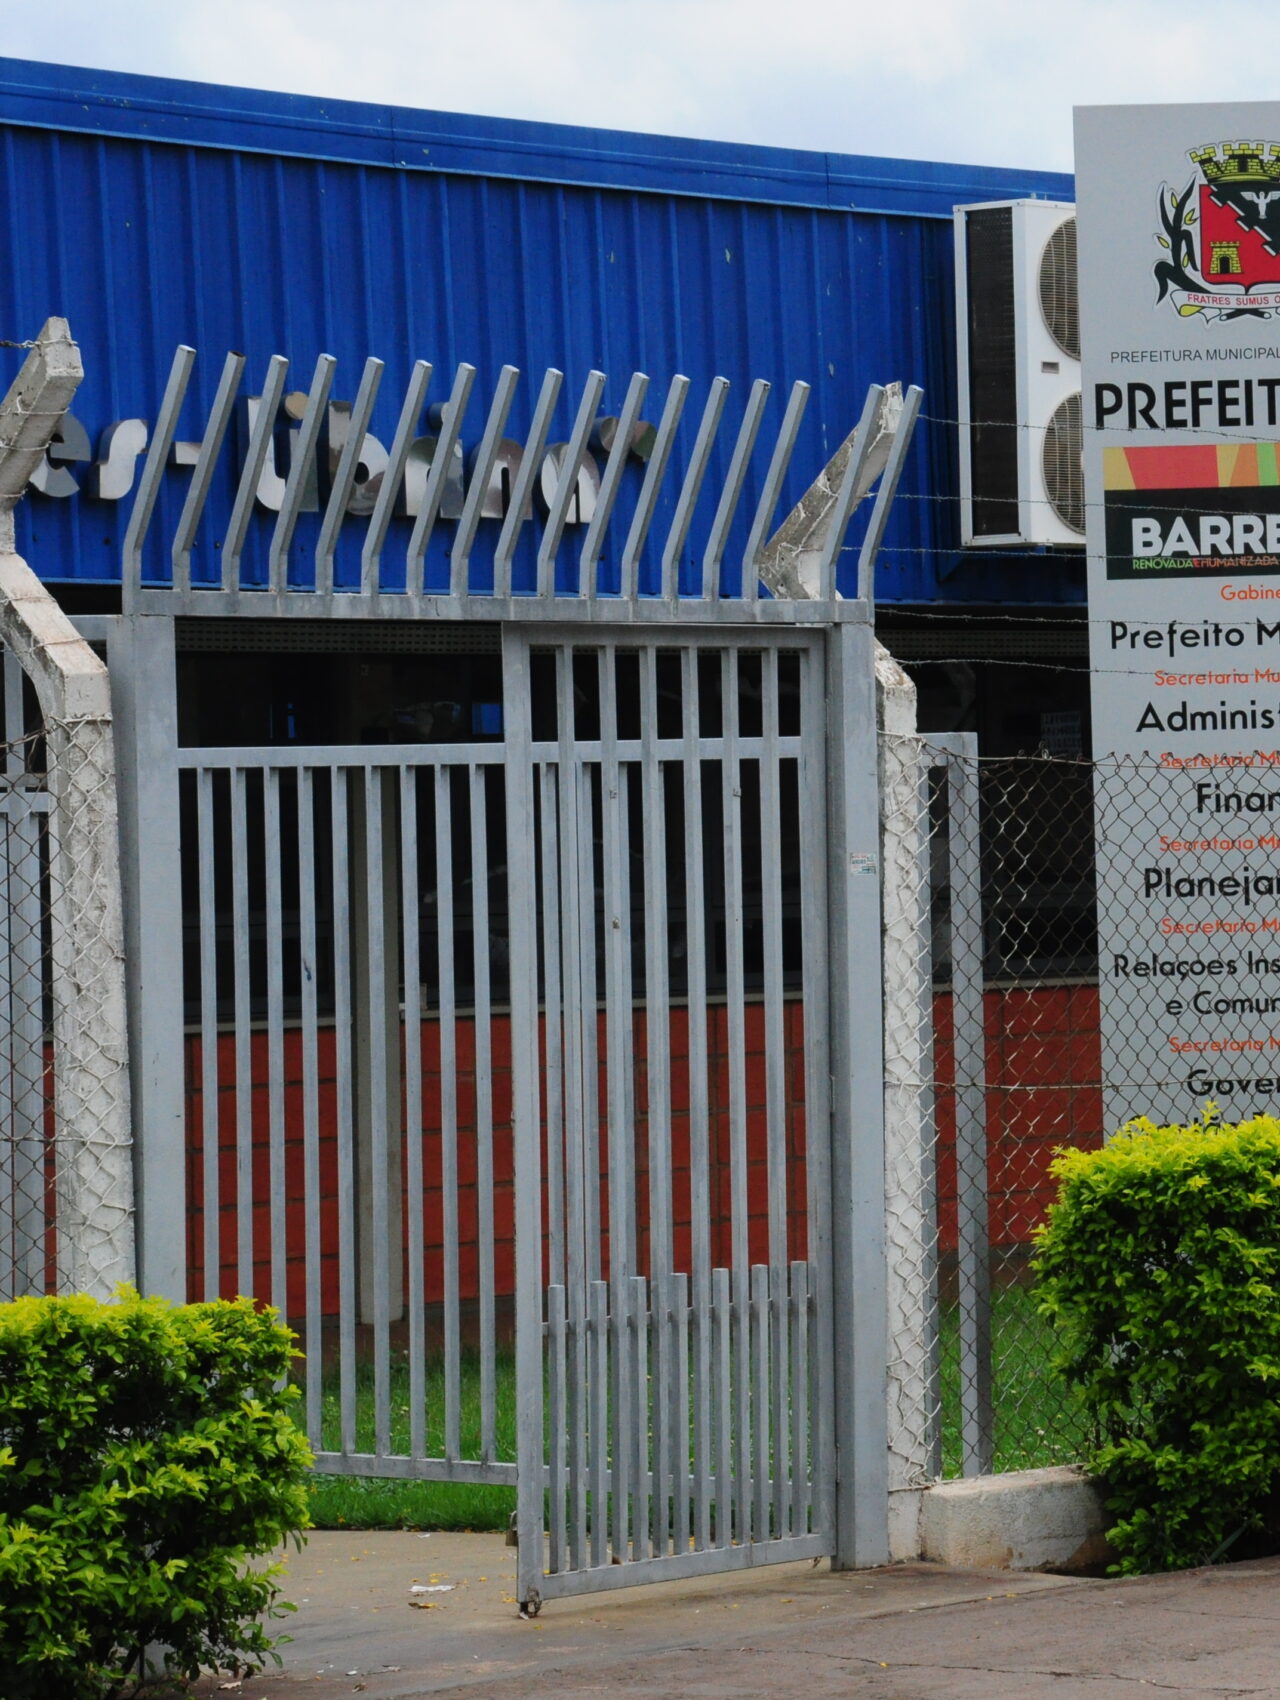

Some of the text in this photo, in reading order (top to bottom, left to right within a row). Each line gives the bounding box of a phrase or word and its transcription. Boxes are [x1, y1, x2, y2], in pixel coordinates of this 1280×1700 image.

[1187, 292, 1231, 306] FRATRES
[1236, 295, 1269, 306] SUMUS
[1110, 350, 1203, 364] PREFEITURA
[1110, 620, 1244, 657] Prefeito
[1154, 669, 1249, 686] Secretaria
[1160, 752, 1254, 769] Secretaria
[1159, 835, 1254, 852] Secretaria
[1161, 916, 1256, 935] Secretaria
[1165, 998, 1183, 1016] e
[1169, 1036, 1264, 1054] Secretaria
